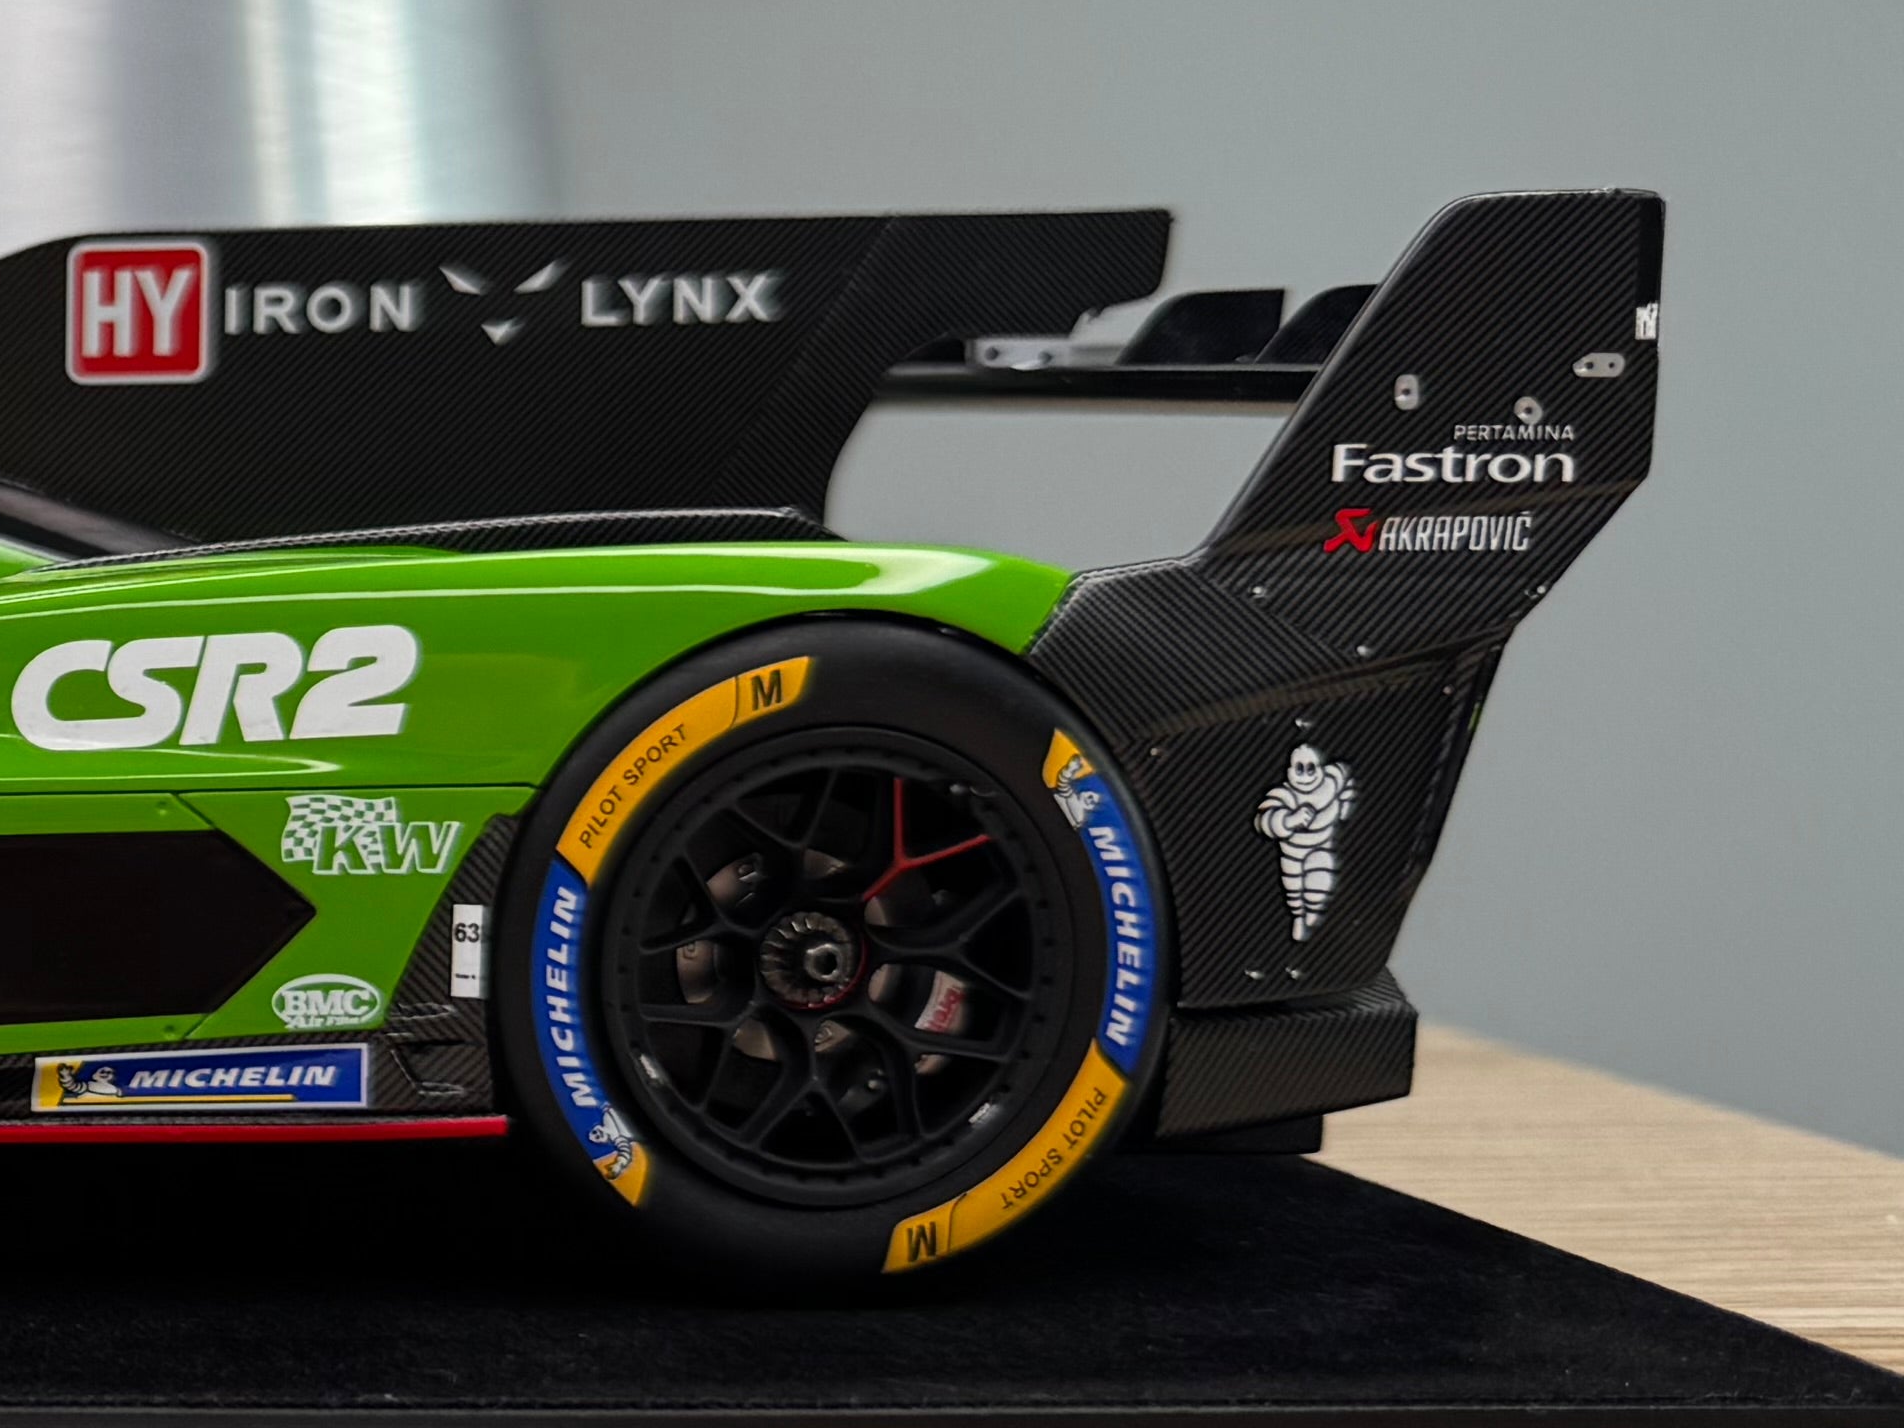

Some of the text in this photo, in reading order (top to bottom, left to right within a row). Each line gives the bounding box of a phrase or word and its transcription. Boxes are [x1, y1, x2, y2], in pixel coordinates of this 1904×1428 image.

[82, 268, 192, 358] HY
[223, 275, 784, 335] IRON LYNX
[1453, 424, 1574, 441] PERTAMINA
[1331, 443, 1574, 484] Fastron
[11, 624, 419, 752] CSR2
[751, 669, 784, 712] M
[578, 723, 687, 850] PILOT SPORT
[312, 821, 461, 875] KW
[455, 922, 480, 943] 63
[1088, 826, 1142, 1047] MICHELIN
[281, 990, 371, 1016] BMC
[546, 886, 598, 1107] MICHELIN
[128, 1065, 336, 1090] MICHELIN
[1000, 1087, 1107, 1210] PILOT SPORT
[906, 1222, 938, 1263] M
